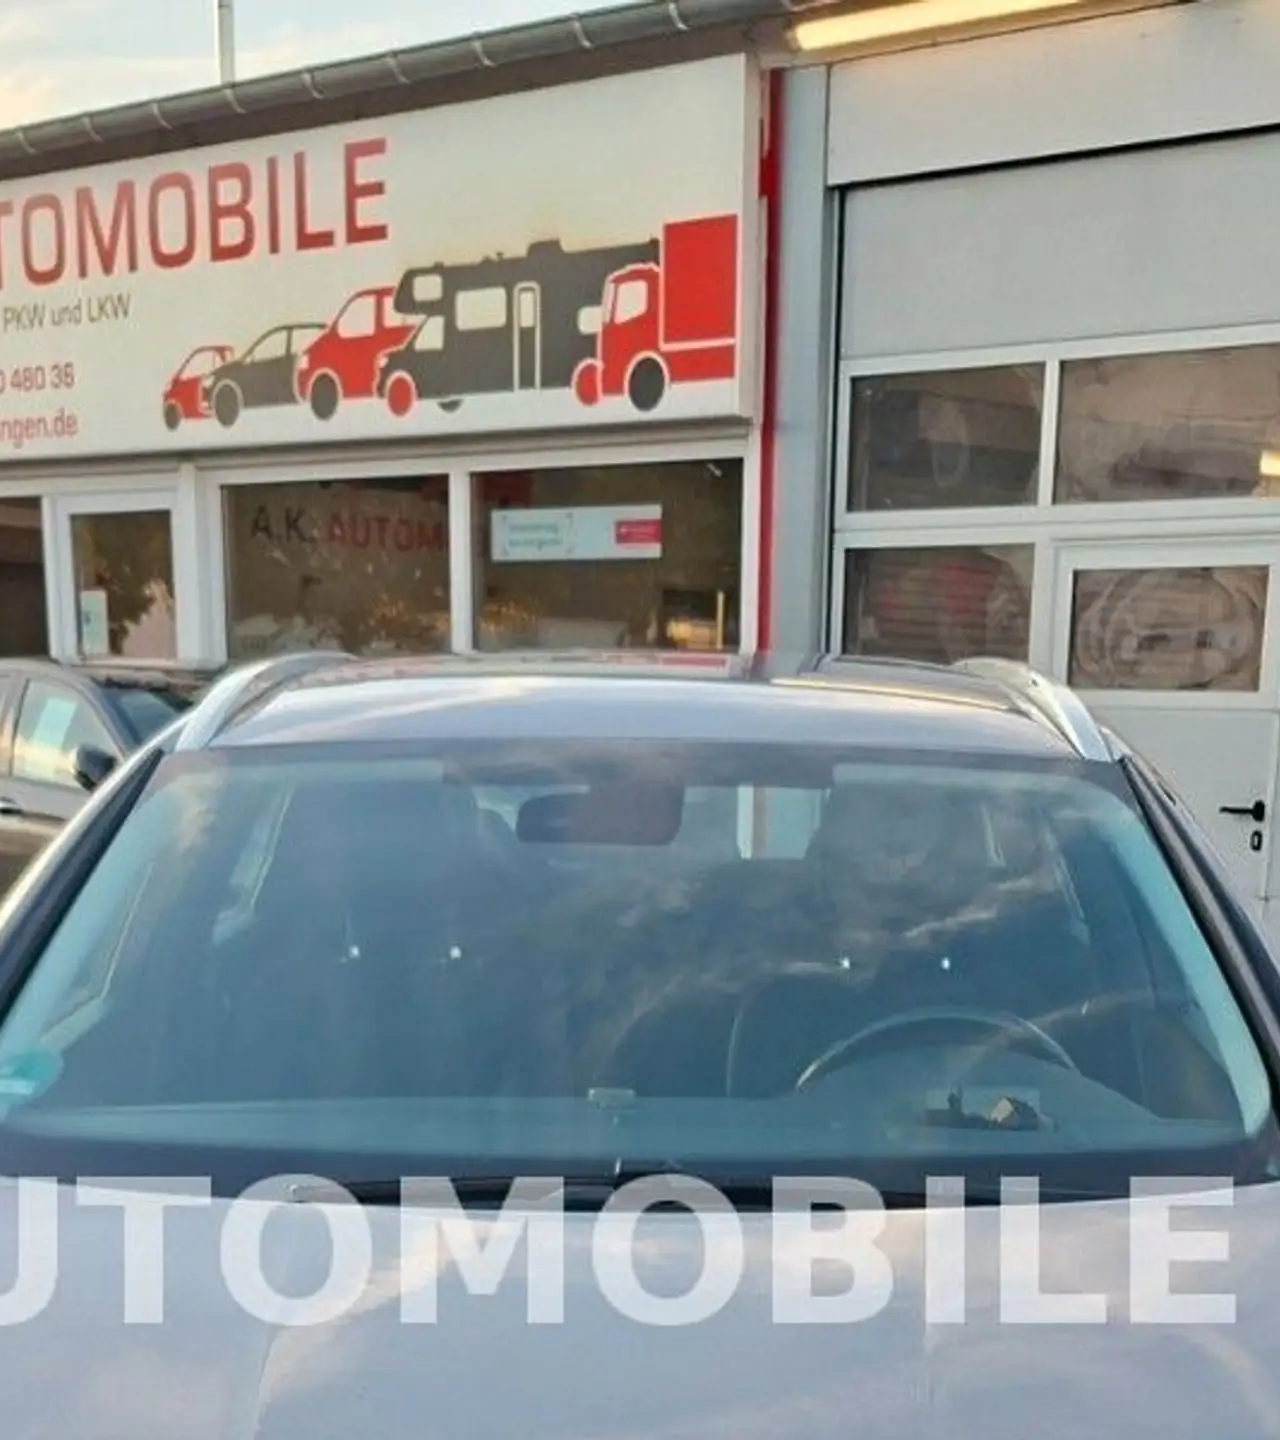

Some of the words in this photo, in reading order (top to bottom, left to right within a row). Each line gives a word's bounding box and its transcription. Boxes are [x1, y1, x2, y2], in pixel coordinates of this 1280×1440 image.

[3, 302, 46, 333] PKW
[51, 300, 83, 327] und
[87, 292, 131, 323] LKW
